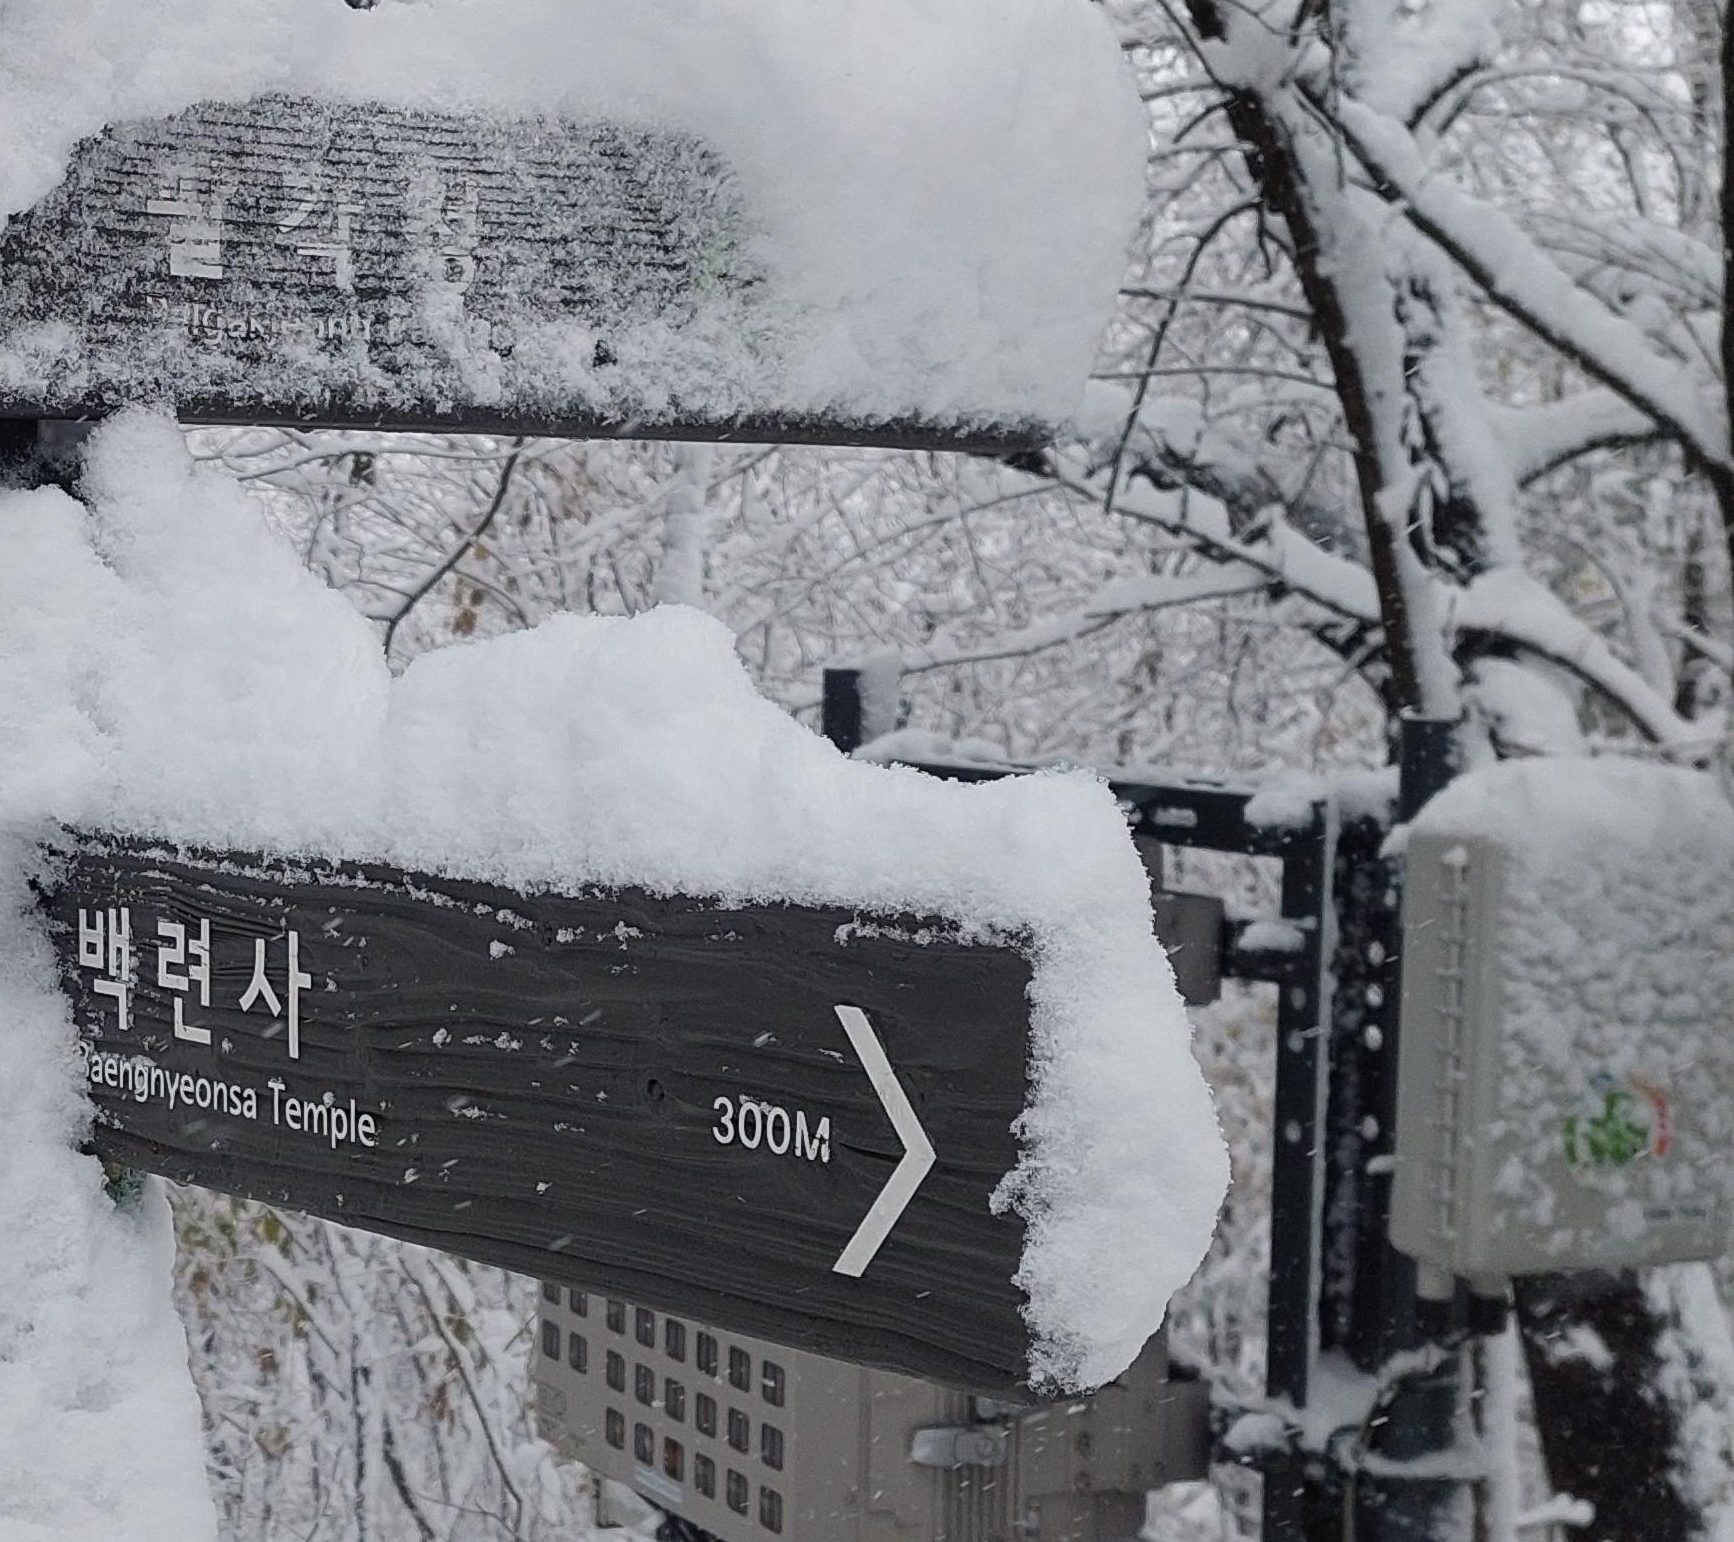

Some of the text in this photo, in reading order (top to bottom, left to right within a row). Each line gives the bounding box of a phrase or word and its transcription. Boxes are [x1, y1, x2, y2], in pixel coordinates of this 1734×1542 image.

[78, 907, 312, 1059] 백련사
[268, 1080, 376, 1148] Temple
[712, 1096, 830, 1163] 300M
